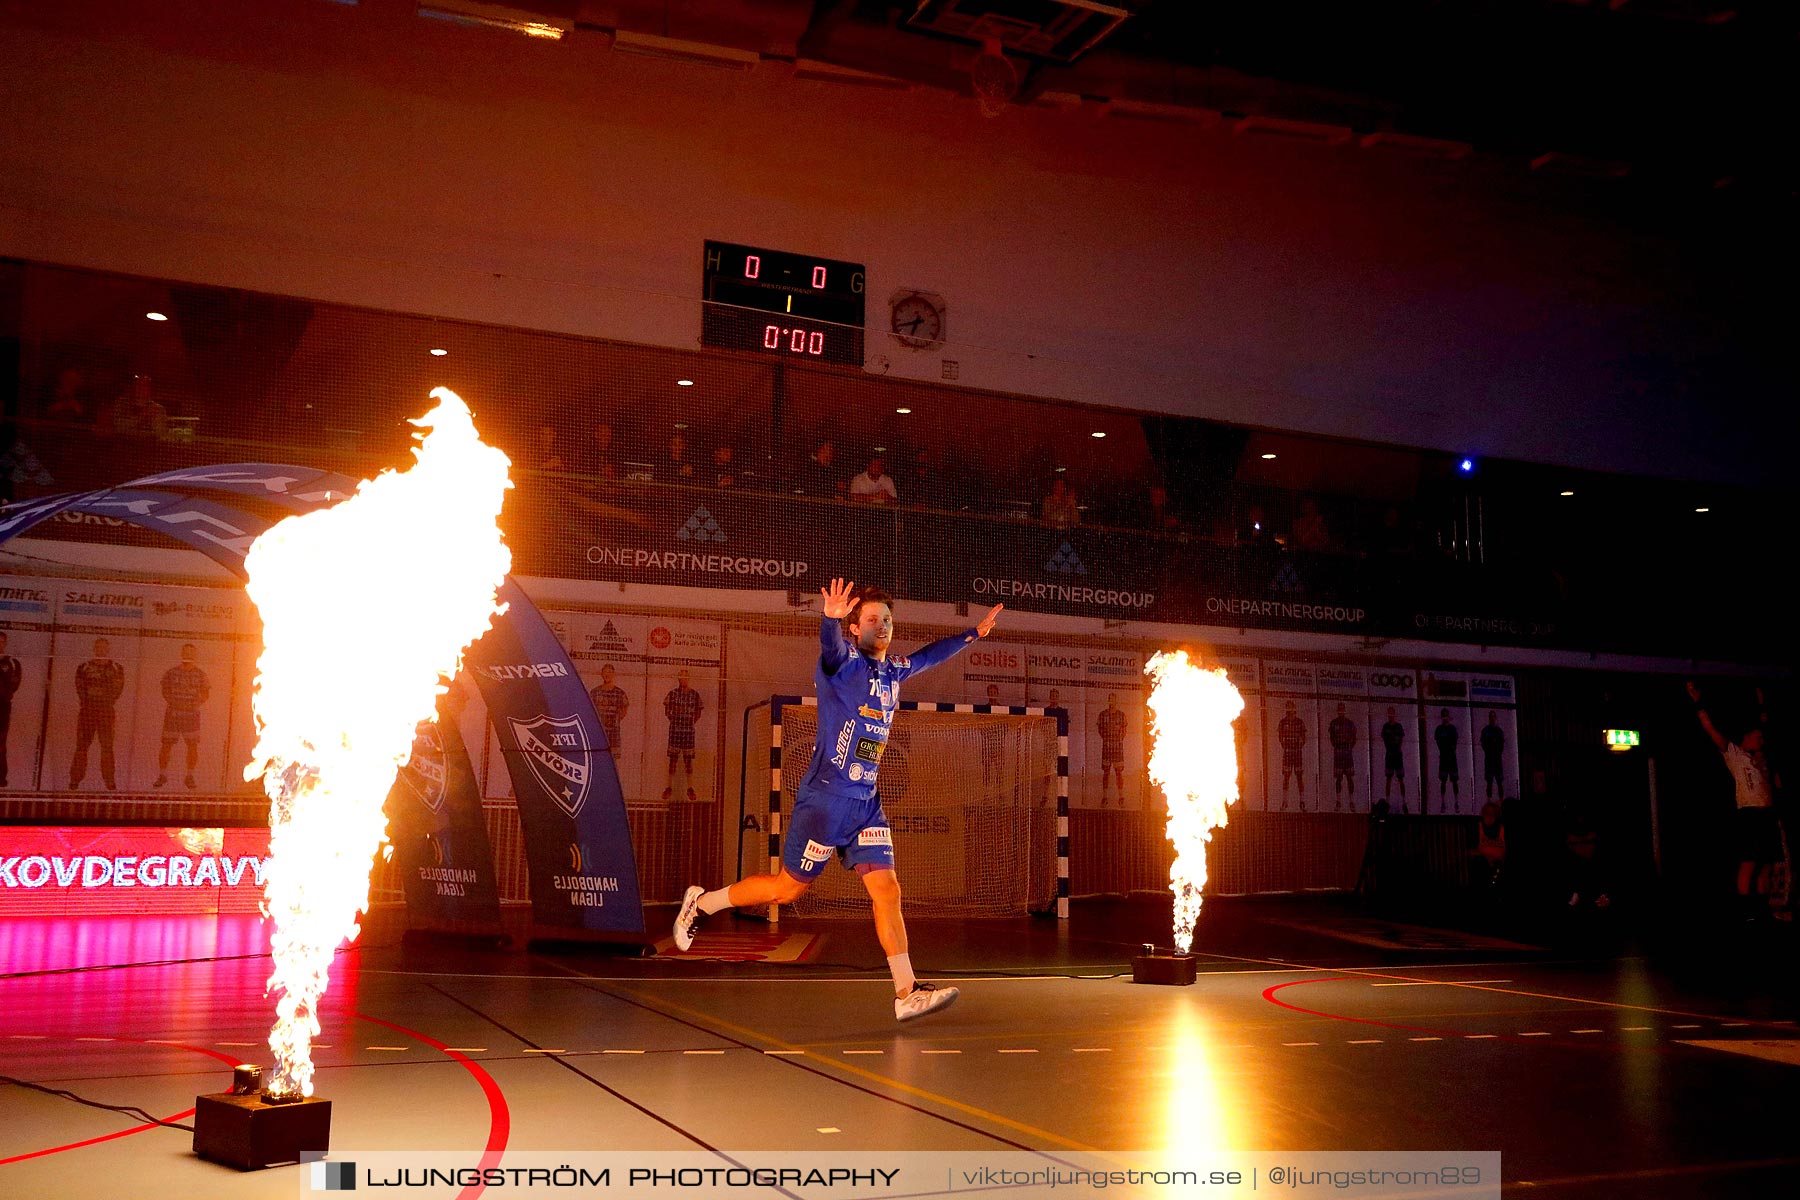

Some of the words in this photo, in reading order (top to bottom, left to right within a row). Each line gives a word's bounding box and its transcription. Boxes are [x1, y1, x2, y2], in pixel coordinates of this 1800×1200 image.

[706, 249, 721, 272] H
[745, 255, 760, 279] 0
[812, 266, 827, 289] 0
[851, 272, 864, 294] G
[586, 546, 808, 577] ONEPARTNERGROUP
[65, 591, 144, 607] SALMING
[973, 577, 1155, 608] ONEPARTNERGROUP
[1206, 597, 1365, 623] ONEPARTNERGROUP
[1087, 655, 1137, 667] SALMING
[1268, 666, 1313, 678] SALMING
[1319, 668, 1363, 680] SALMING
[1471, 678, 1512, 690] SALMING
[800, 858, 814, 872] 10
